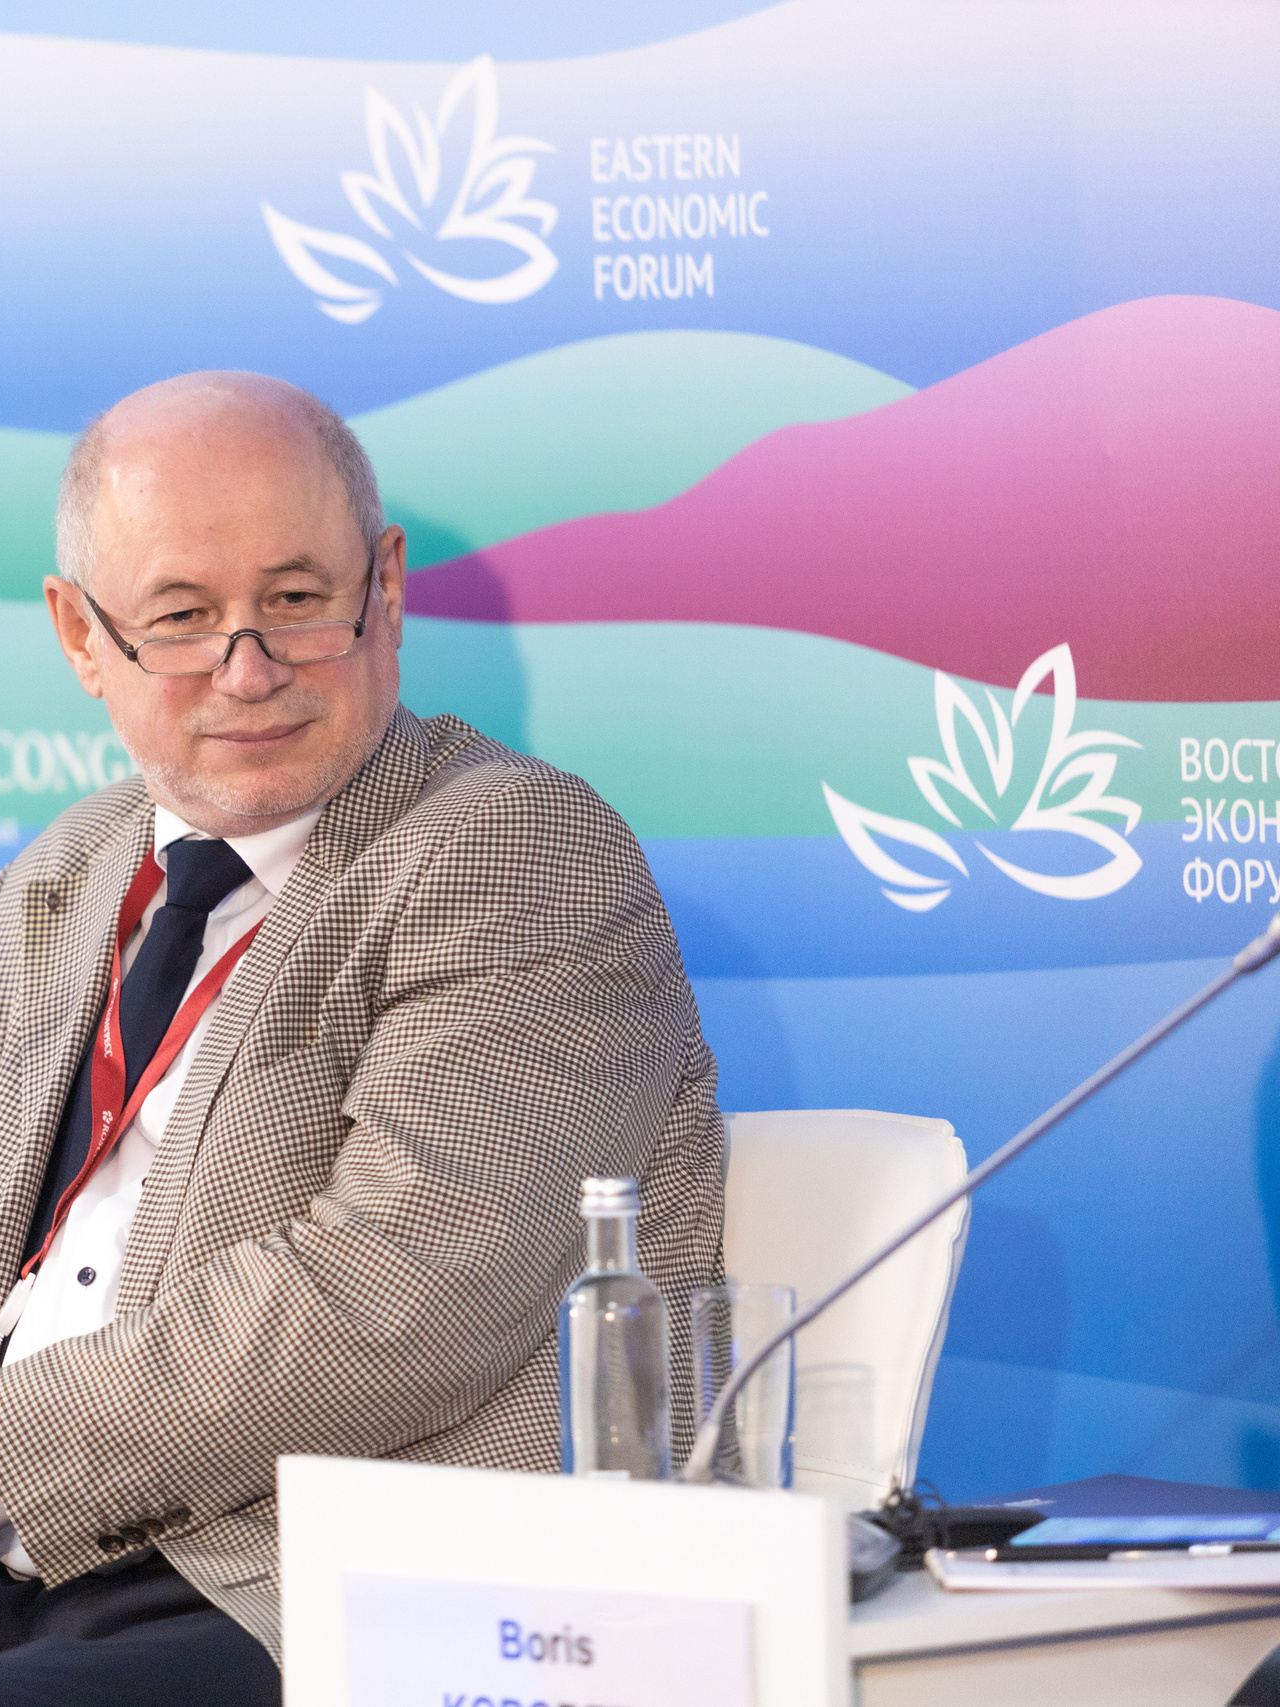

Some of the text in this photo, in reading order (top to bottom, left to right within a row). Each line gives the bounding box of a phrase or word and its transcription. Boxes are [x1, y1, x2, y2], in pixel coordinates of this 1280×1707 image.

[590, 133, 740, 183] EASTERN
[592, 190, 769, 242] ECONOMIC
[594, 252, 715, 301] FORUM
[1180, 737, 1280, 783] ВОСТ
[499, 1618, 595, 1667] Boris
